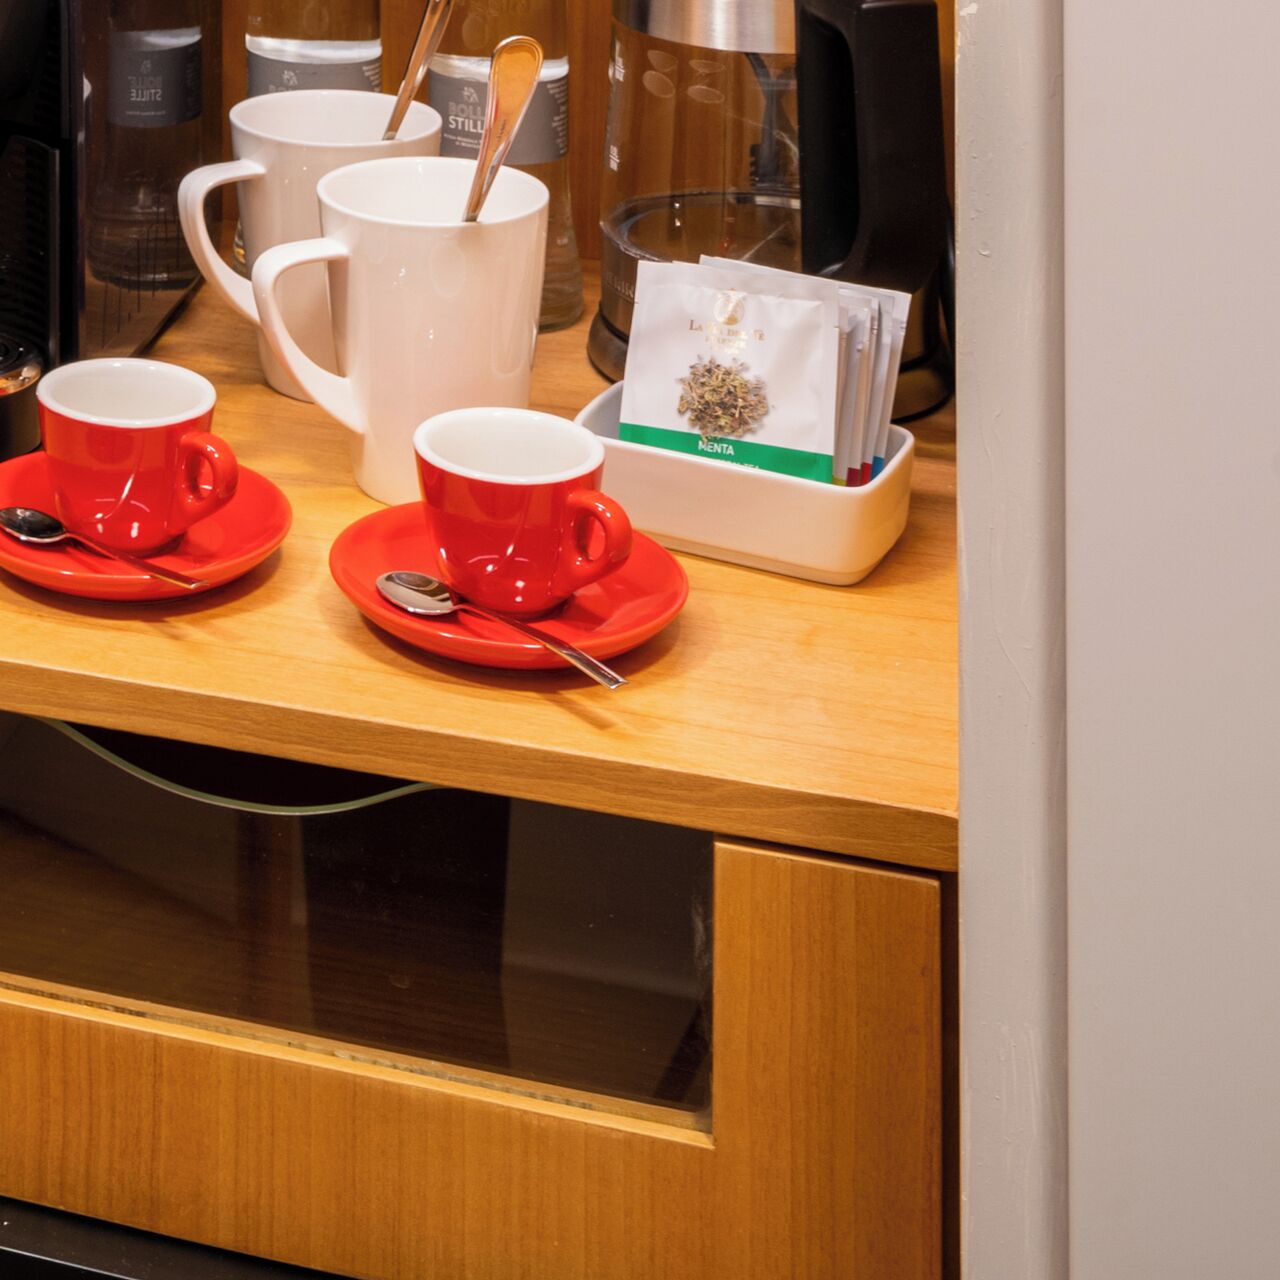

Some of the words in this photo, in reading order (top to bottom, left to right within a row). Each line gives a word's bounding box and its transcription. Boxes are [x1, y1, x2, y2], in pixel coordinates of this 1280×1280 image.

[449, 101, 486, 117] BOLL
[448, 116, 486, 133] STILL
[697, 440, 736, 457] MENTA
